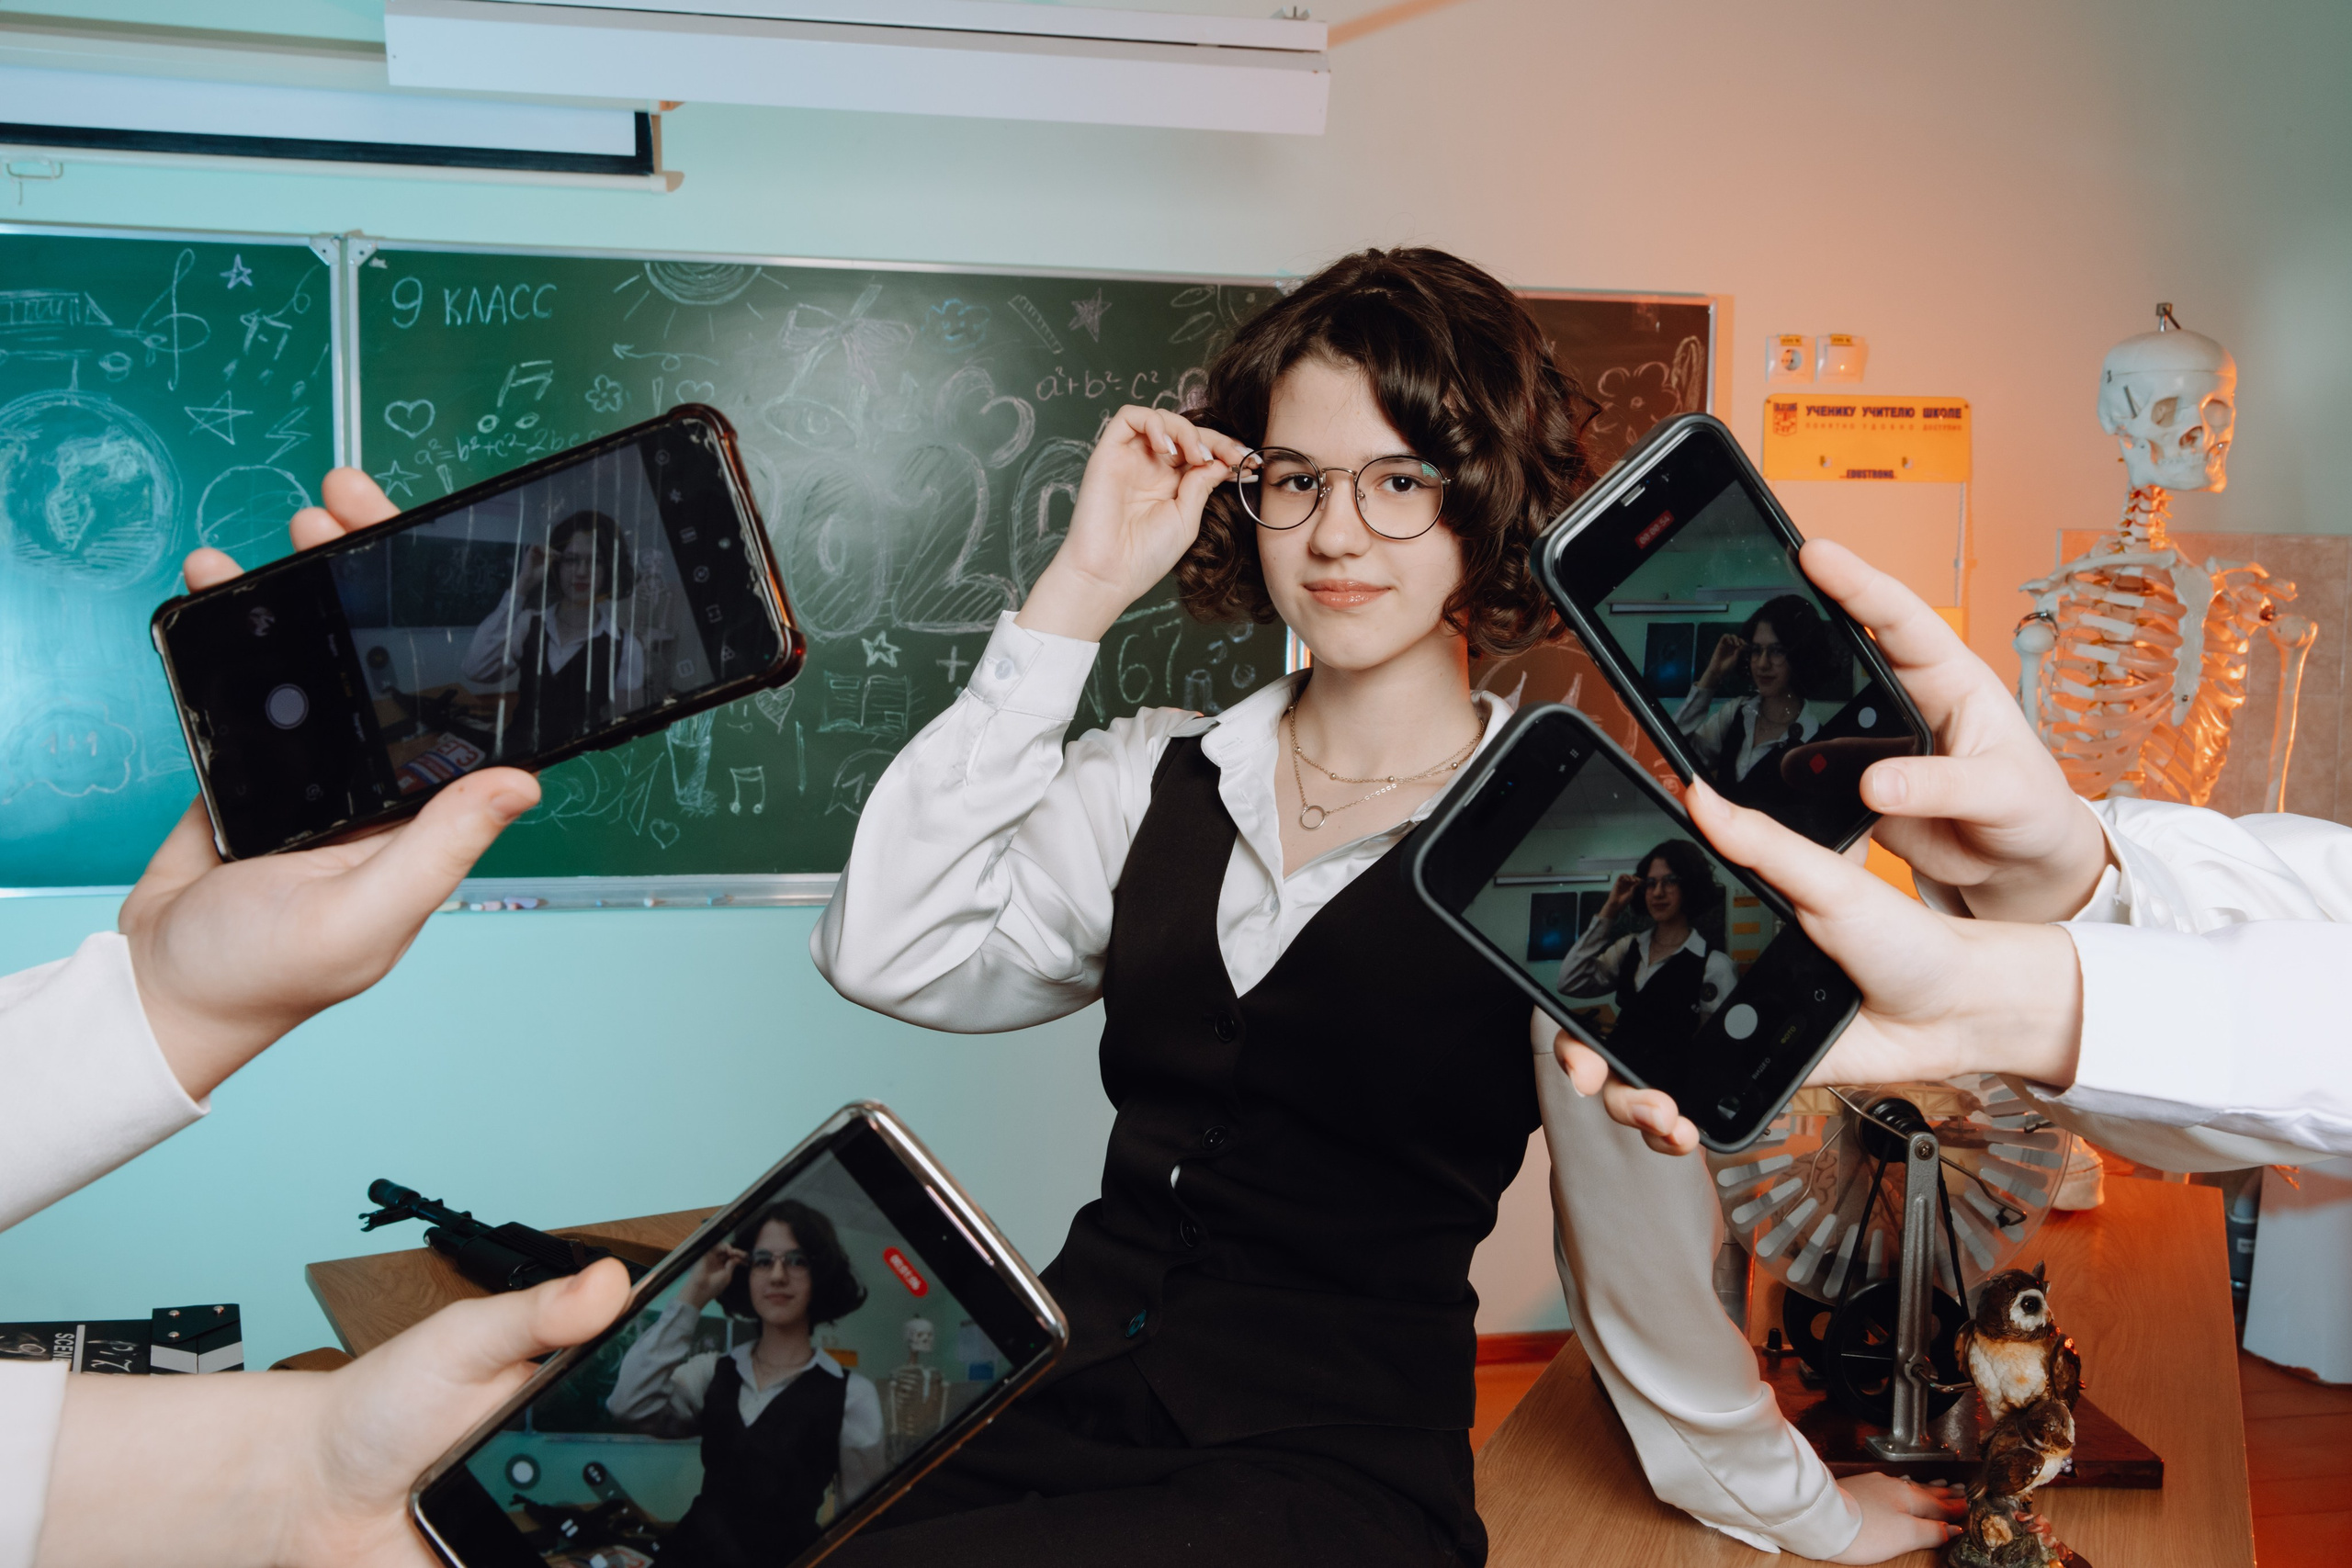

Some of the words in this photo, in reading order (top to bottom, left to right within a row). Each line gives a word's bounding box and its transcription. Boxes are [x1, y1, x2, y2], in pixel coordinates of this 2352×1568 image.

[391, 276, 424, 329] 9
[444, 283, 558, 326] КЛАСС
[1805, 405, 1856, 417] УЧЕНИКУ
[1861, 406, 1915, 418] УЧИТЕЛЮ
[1923, 408, 1962, 419] ШКОЛЕ
[1846, 469, 1894, 479] EDUSTRONG
[1780, 1025, 1797, 1044] ФОТО
[1751, 1057, 1771, 1080] ВИДЕО
